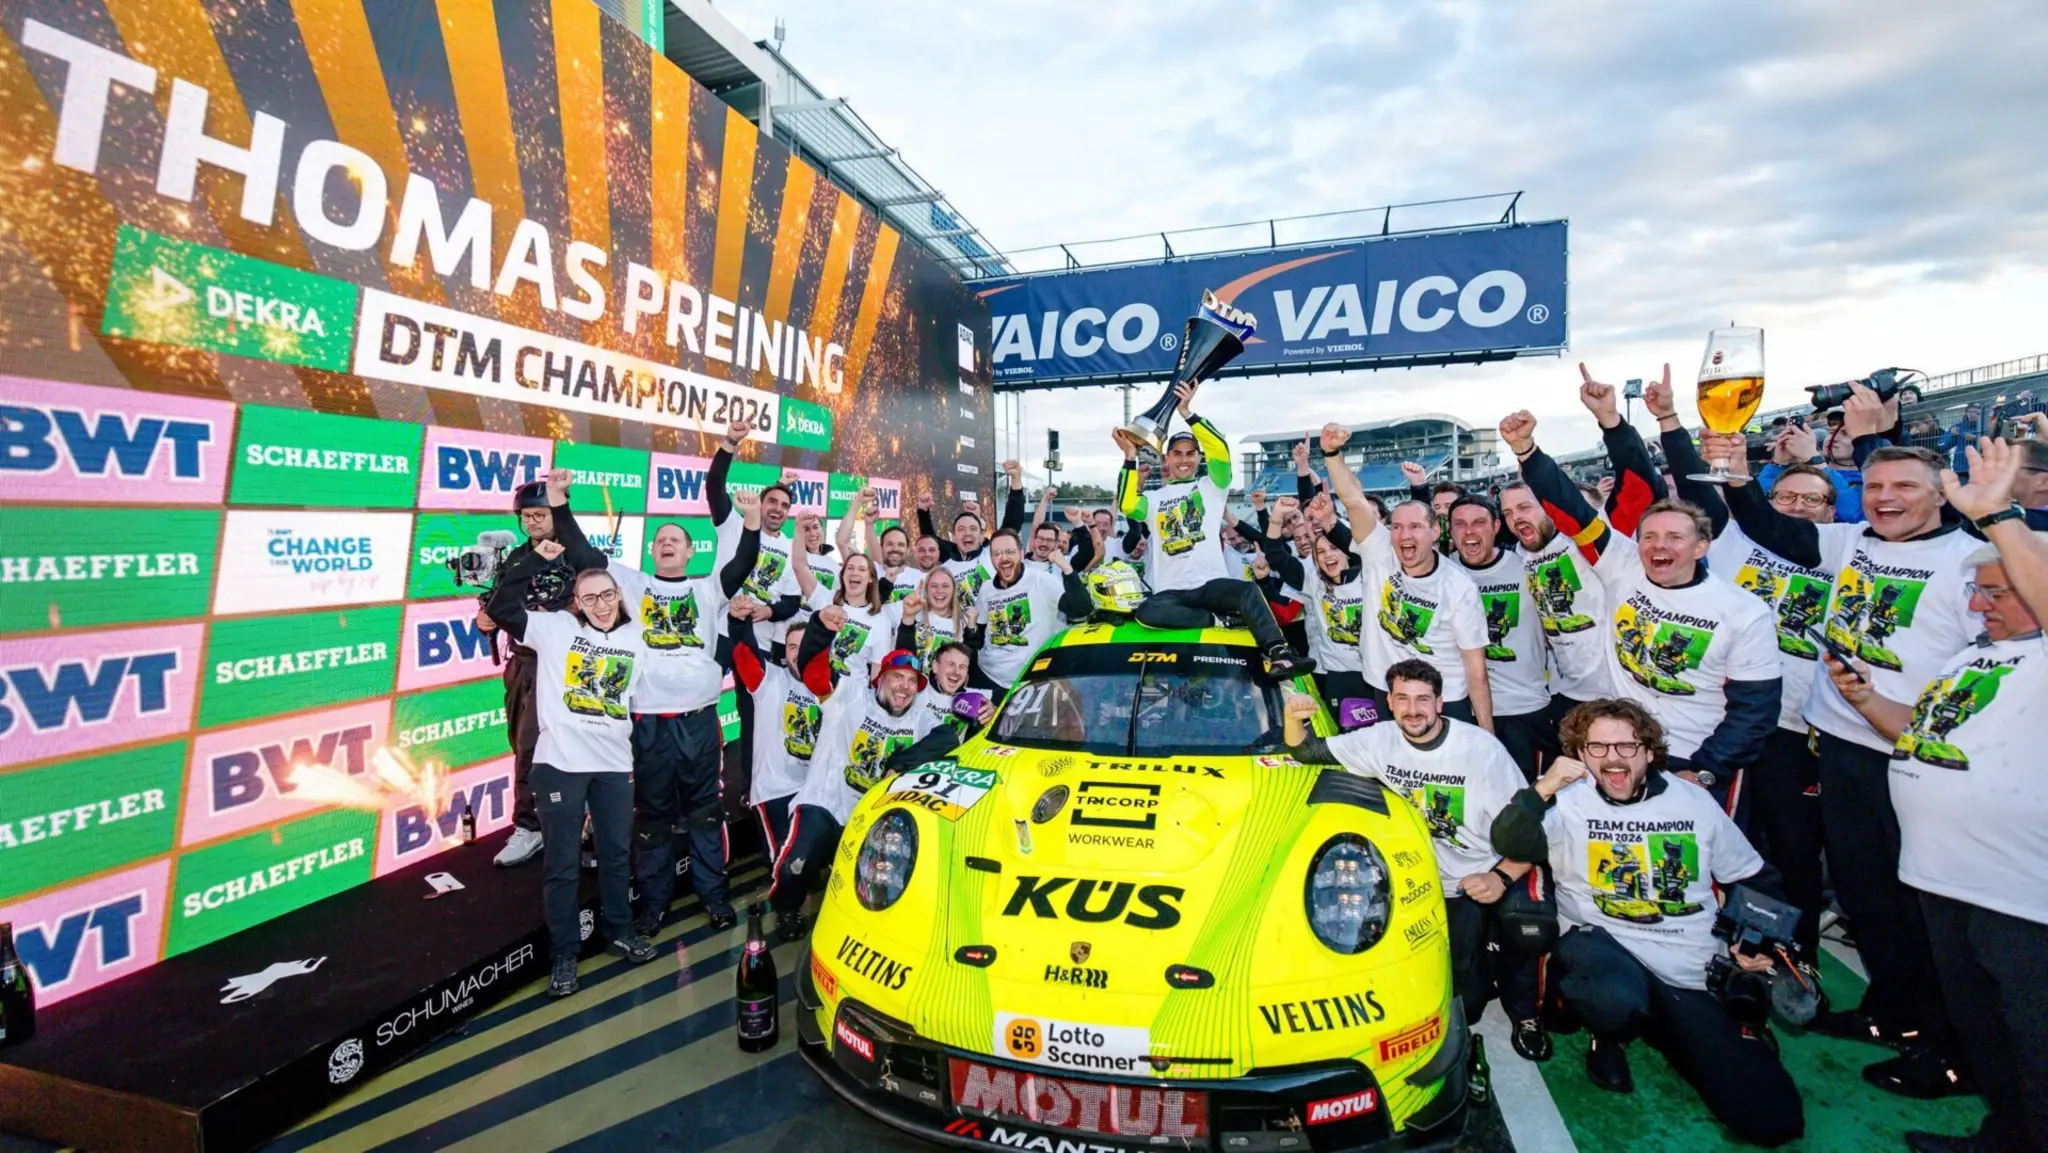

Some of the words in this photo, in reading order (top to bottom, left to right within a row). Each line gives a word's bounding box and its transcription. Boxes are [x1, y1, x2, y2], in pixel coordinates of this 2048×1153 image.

[22, 17, 608, 322] THOMAS
[622, 261, 845, 393] PREINING
[206, 285, 325, 337] DEKRA
[1273, 269, 1527, 342] VAICO
[1283, 346, 1315, 356] Powered
[1316, 346, 1325, 355] by
[378, 312, 502, 384] DTM
[514, 346, 707, 422] CHAMPION
[712, 391, 773, 432] 2026
[798, 418, 826, 436] DEKRA
[0, 406, 211, 480] BWT
[247, 444, 410, 475] SCHAEFFLER
[437, 446, 542, 492] BWT
[568, 469, 642, 489] CHAEFFLER
[656, 466, 707, 501] BW
[268, 537, 372, 557] CHANGE
[0, 553, 200, 585] HAEFFLER
[292, 557, 373, 574] WORLD
[848, 618, 872, 630] AMPION
[417, 618, 492, 667] BW
[570, 644, 588, 653] DTM
[216, 642, 388, 684] SCHAEFFLER
[1128, 652, 1178, 663] DTM
[1193, 655, 1248, 666] PREINING
[1006, 682, 1051, 717] 91
[399, 708, 508, 749] SCHAEFFLE
[860, 723, 874, 733] DTM
[210, 725, 373, 813] BWT
[1085, 760, 1226, 779] TRILUX
[1386, 764, 1411, 779] TEAM
[1403, 779, 1424, 788] 2026
[912, 772, 960, 798] 91
[396, 775, 510, 856] BWT
[890, 790, 948, 812] ADAC
[1076, 795, 1159, 808] TRICORP
[1587, 819, 1623, 832] TEAM
[1627, 820, 1695, 832] CHAMPION
[1588, 831, 1613, 841] DTM
[1615, 833, 1643, 842] 2026
[1068, 832, 1155, 849] WORKWEAR
[183, 838, 365, 918] SCHAEFFLER
[1001, 875, 1186, 930] KÜS
[15, 898, 143, 989] WT
[836, 934, 913, 990] VELTINS
[1044, 965, 1085, 982] H&R
[376, 943, 534, 1047] SCHUMACHER
[451, 997, 475, 1014] WINES
[1258, 990, 1386, 1035] VELTINS
[837, 1022, 871, 1058] MOTUL
[1049, 1023, 1105, 1048] Lotto
[1379, 1016, 1441, 1062] PIRELLI
[1047, 1046, 1137, 1072] Scanner
[960, 1063, 1202, 1138] MOTUL
[1310, 1093, 1374, 1122] MOTUL
[990, 1127, 1146, 1153] MANT
